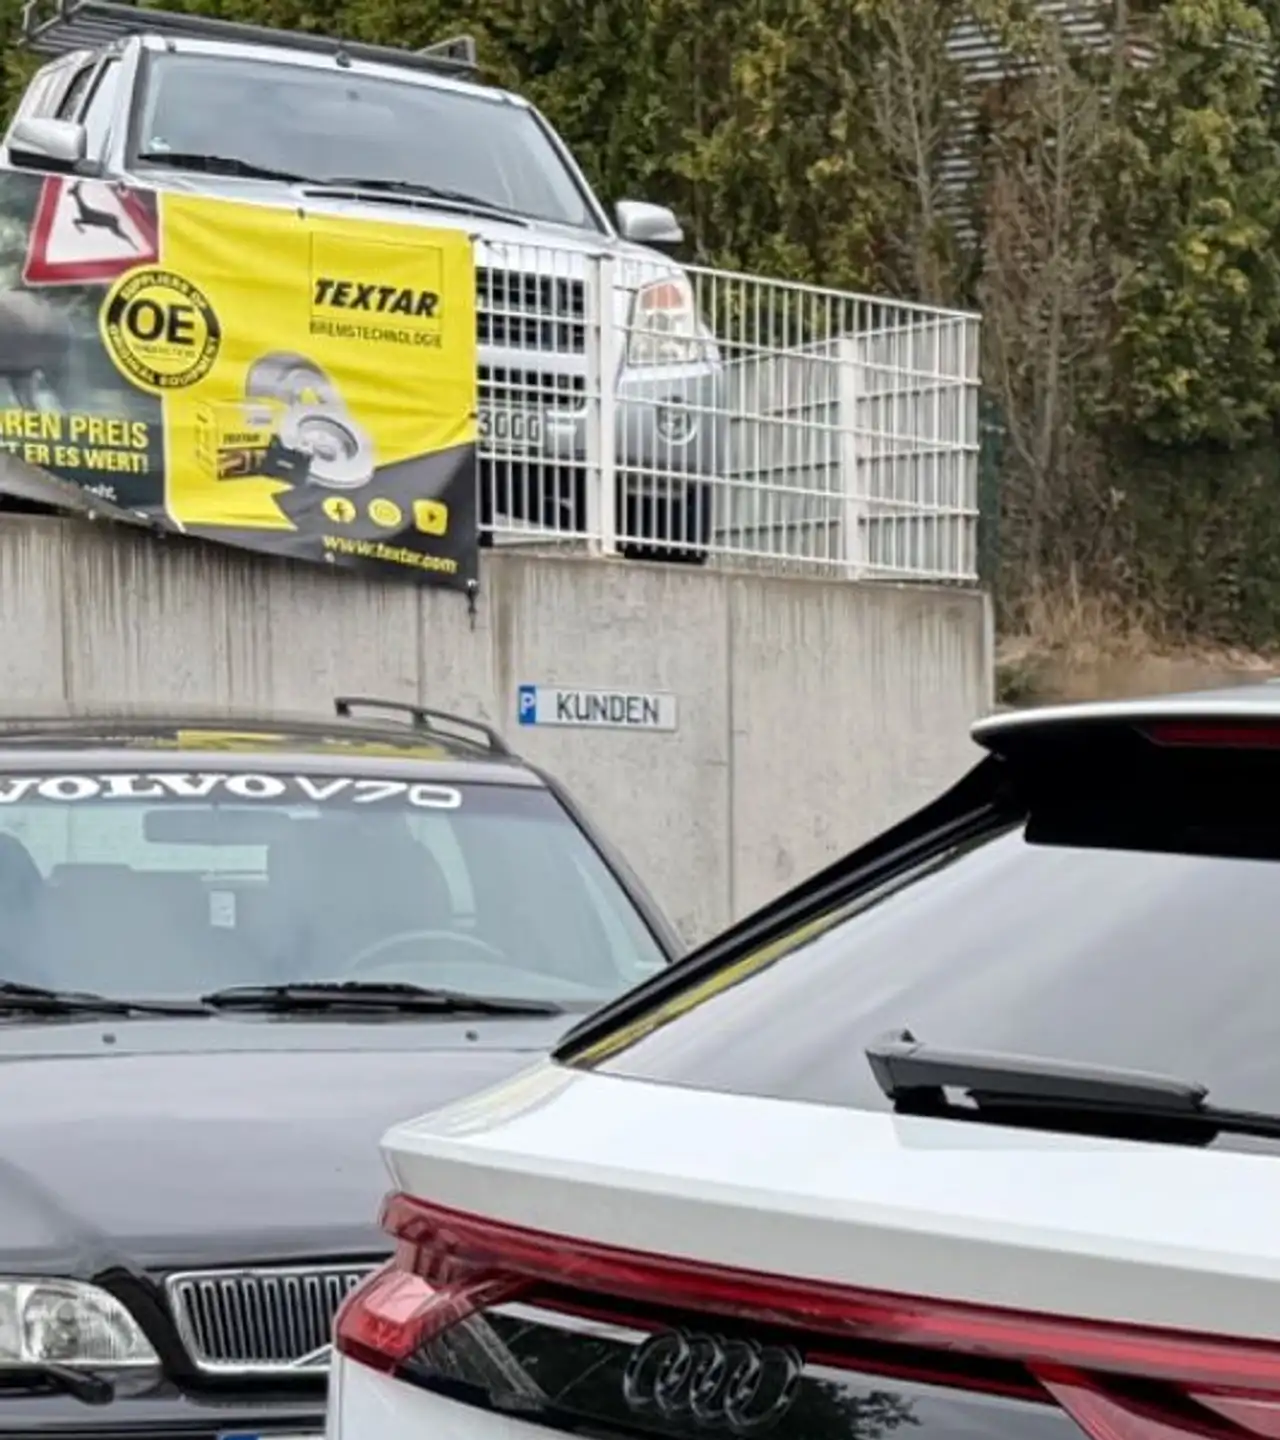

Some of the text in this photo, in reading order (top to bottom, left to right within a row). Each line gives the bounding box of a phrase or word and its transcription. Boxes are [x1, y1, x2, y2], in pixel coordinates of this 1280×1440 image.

[314, 278, 439, 319] TEXTAR
[127, 298, 196, 346] OE
[0, 409, 149, 449] REN PREIS
[24, 442, 50, 466] ER
[54, 445, 80, 468] ES
[84, 448, 149, 475] WERT!
[321, 534, 459, 575] www.textar.com
[555, 691, 660, 725] KUNDEN
[292, 775, 463, 809] V70
